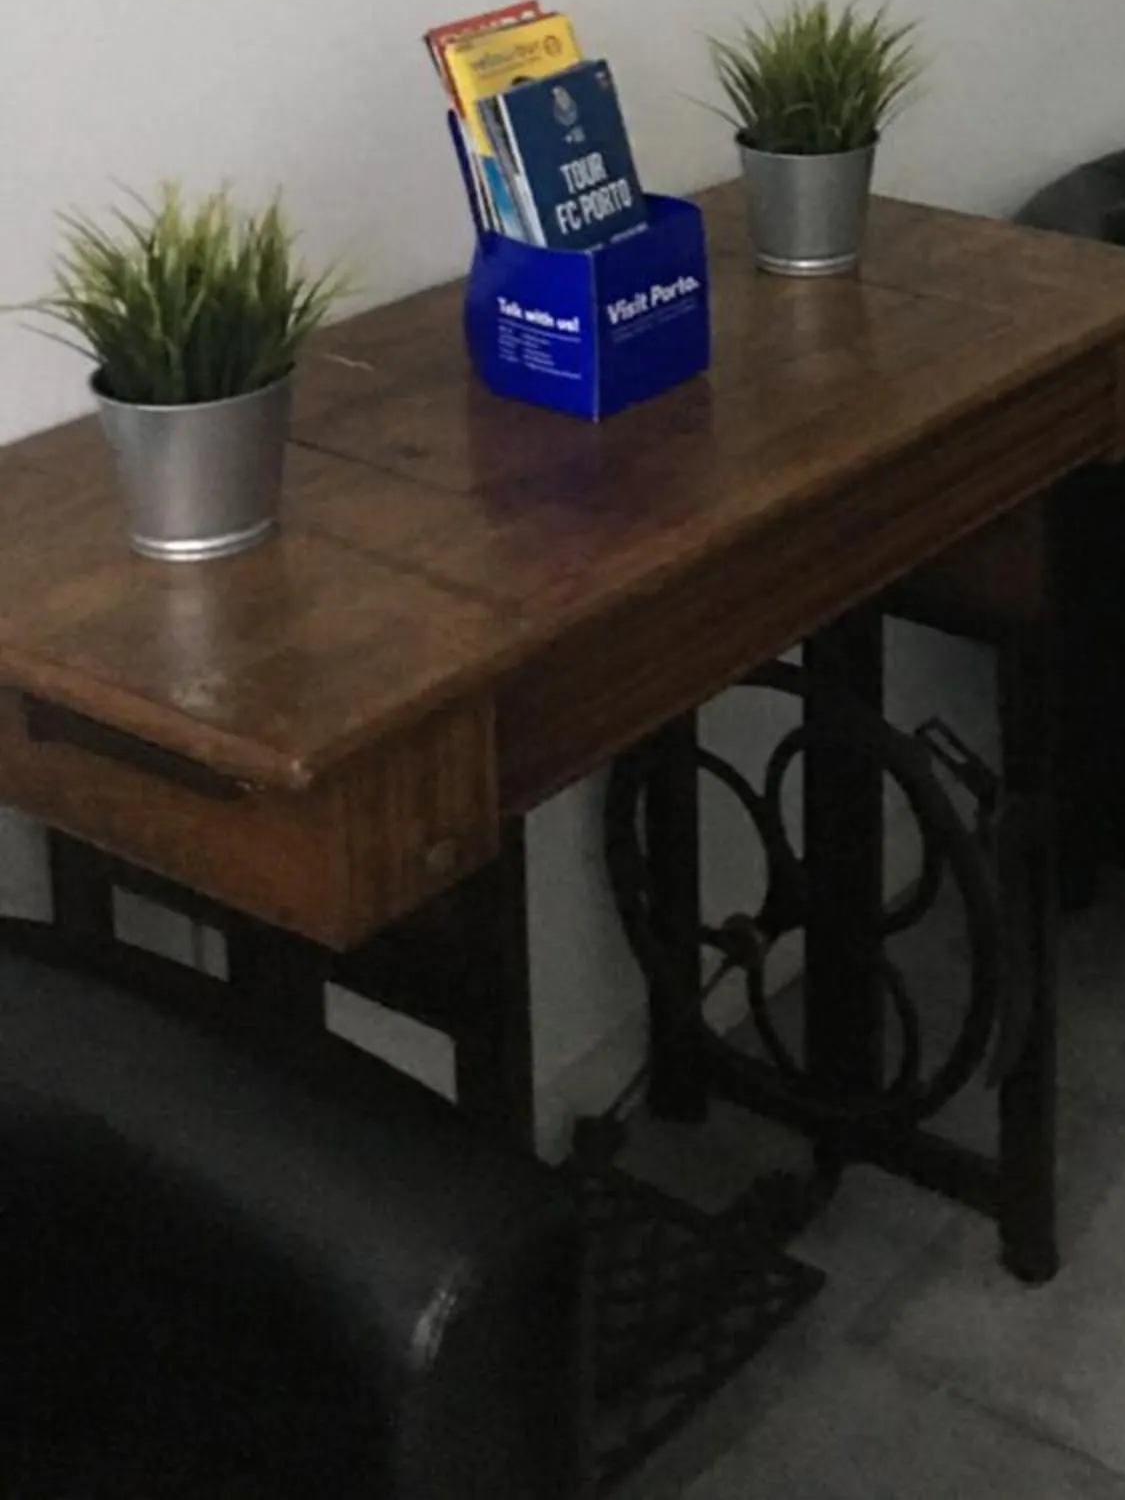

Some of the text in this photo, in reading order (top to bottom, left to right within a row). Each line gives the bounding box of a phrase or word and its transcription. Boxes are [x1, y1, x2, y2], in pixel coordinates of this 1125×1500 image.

[560, 152, 608, 194] TOUR
[555, 178, 632, 235] FC PORTO
[524, 308, 555, 328] with
[607, 292, 649, 325] Visit
